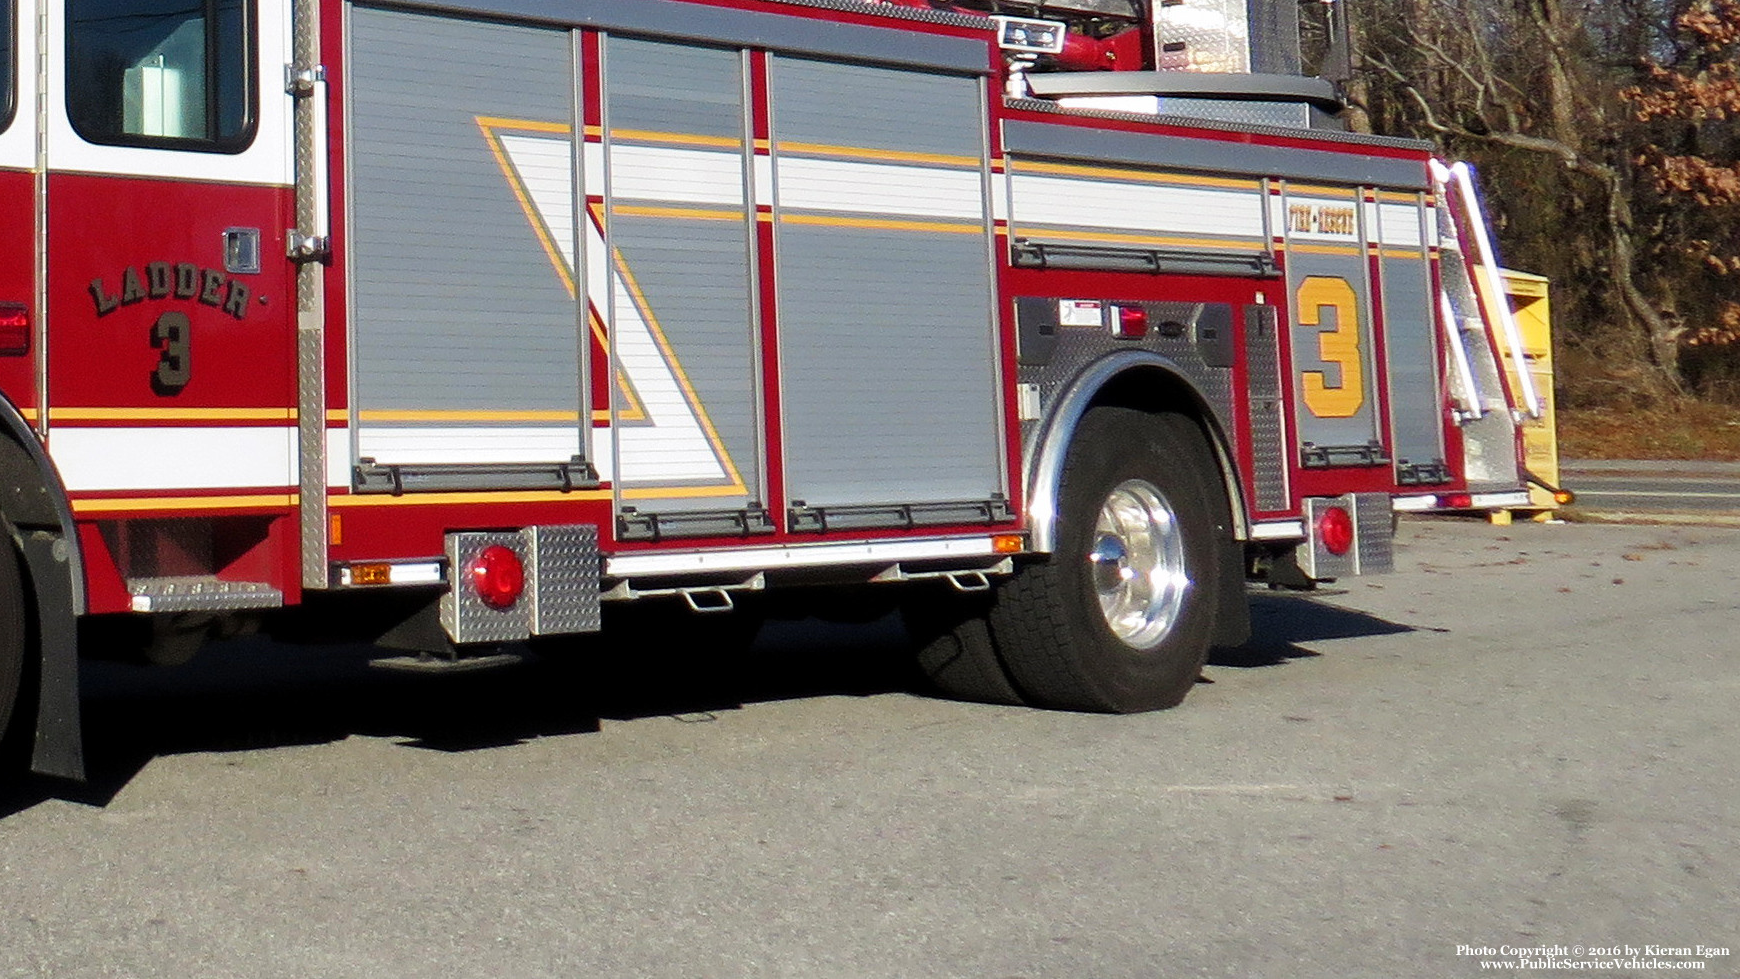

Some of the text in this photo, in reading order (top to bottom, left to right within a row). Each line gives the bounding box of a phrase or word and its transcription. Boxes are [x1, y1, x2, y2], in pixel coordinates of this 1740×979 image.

[87, 260, 251, 320] LADDER
[148, 310, 192, 397] 3
[1296, 275, 1365, 418] 3
